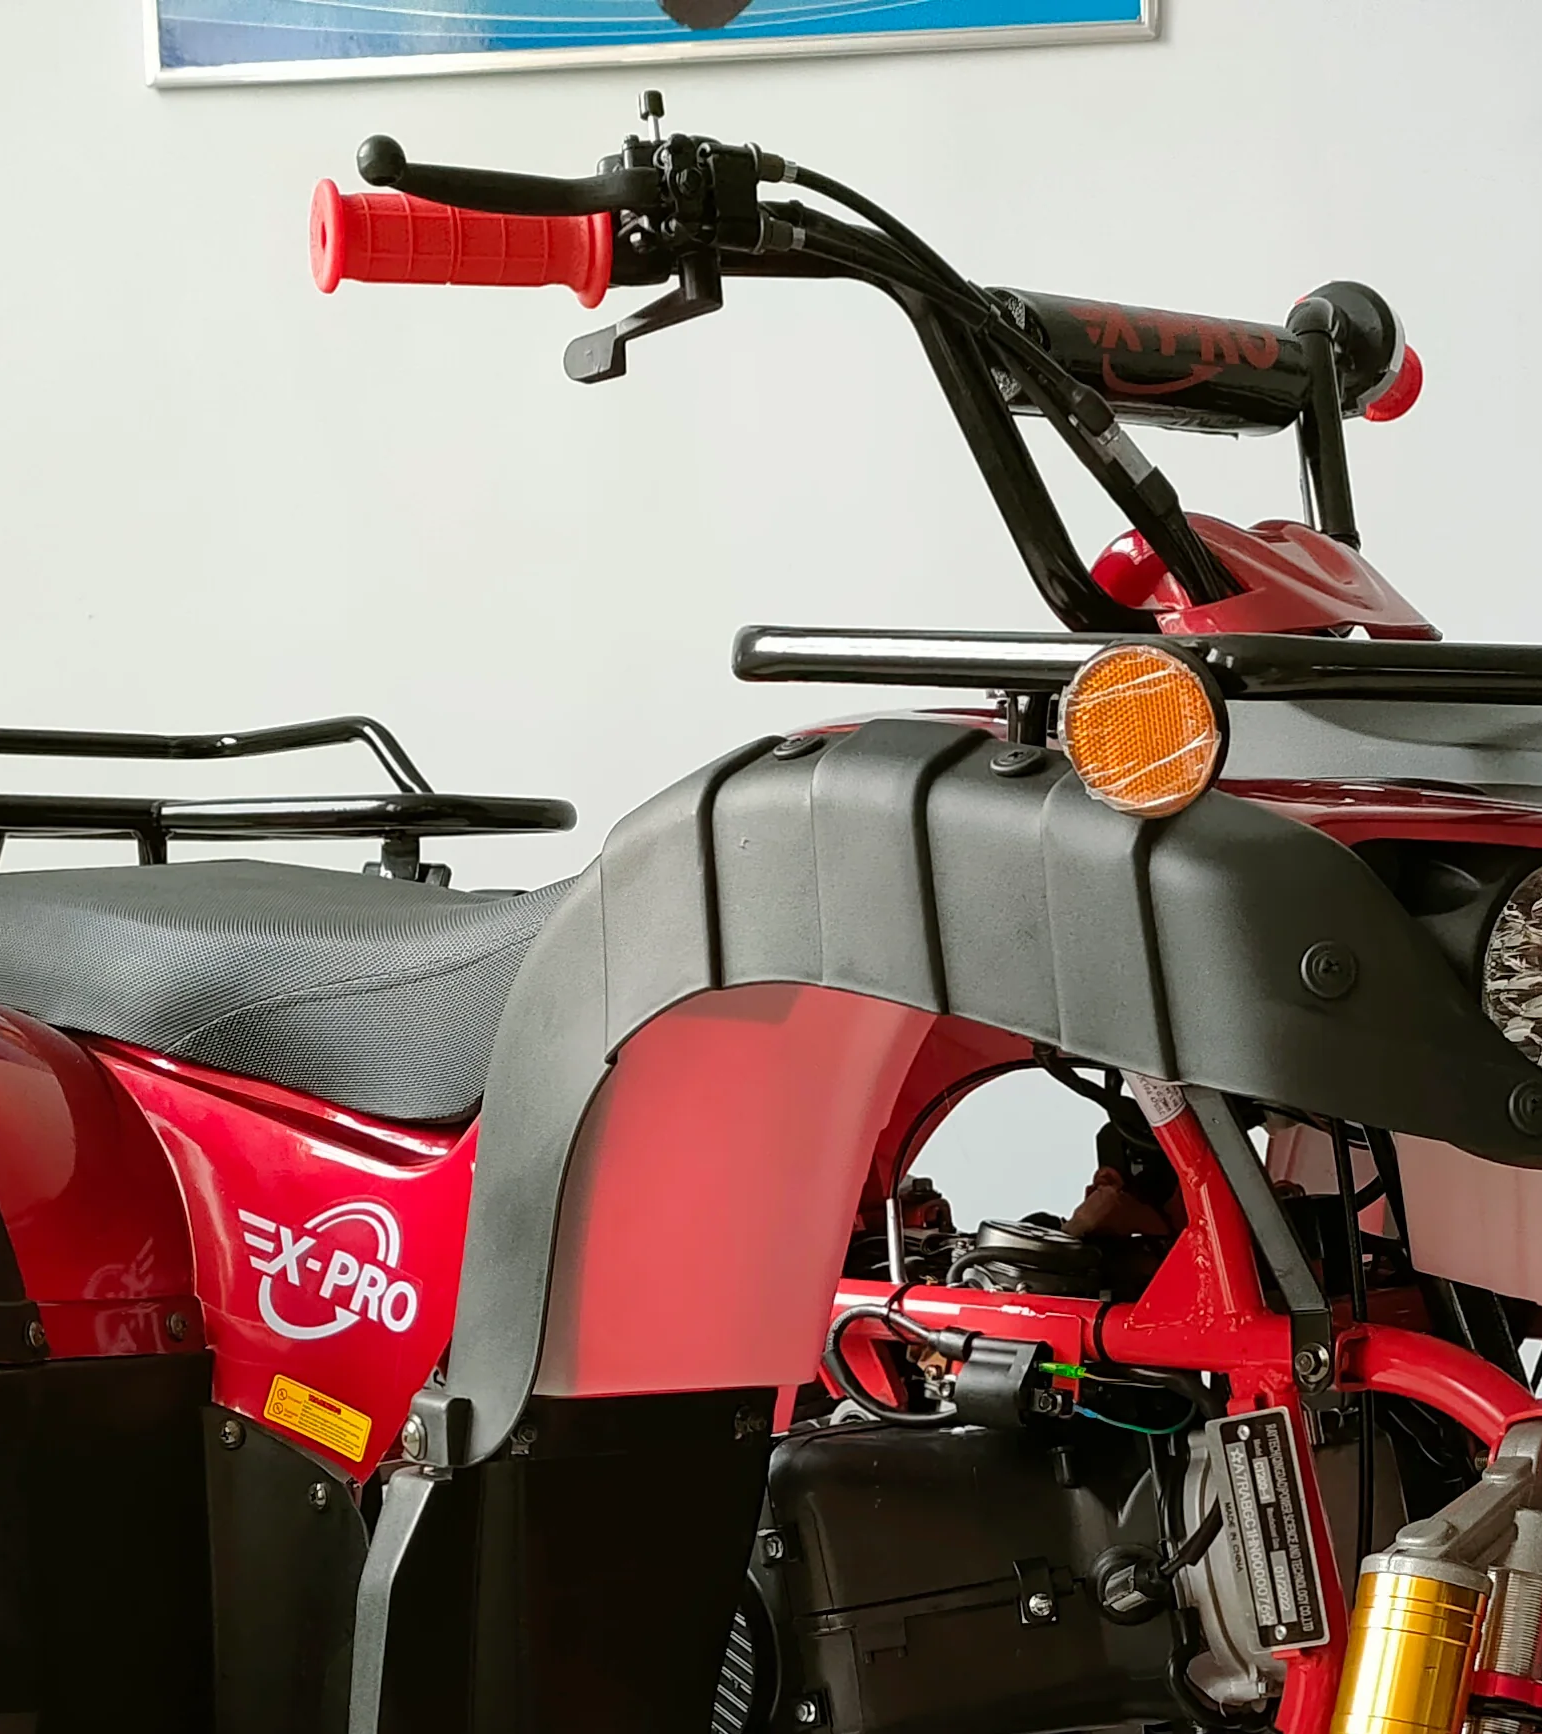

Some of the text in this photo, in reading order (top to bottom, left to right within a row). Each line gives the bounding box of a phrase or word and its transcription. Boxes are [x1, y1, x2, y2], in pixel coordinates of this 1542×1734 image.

[1223, 1501, 1243, 1572] MADE IN CHINA
[1273, 1565, 1291, 1611] 01/2022
[1289, 1558, 1310, 1605] TECHNOLOGY
